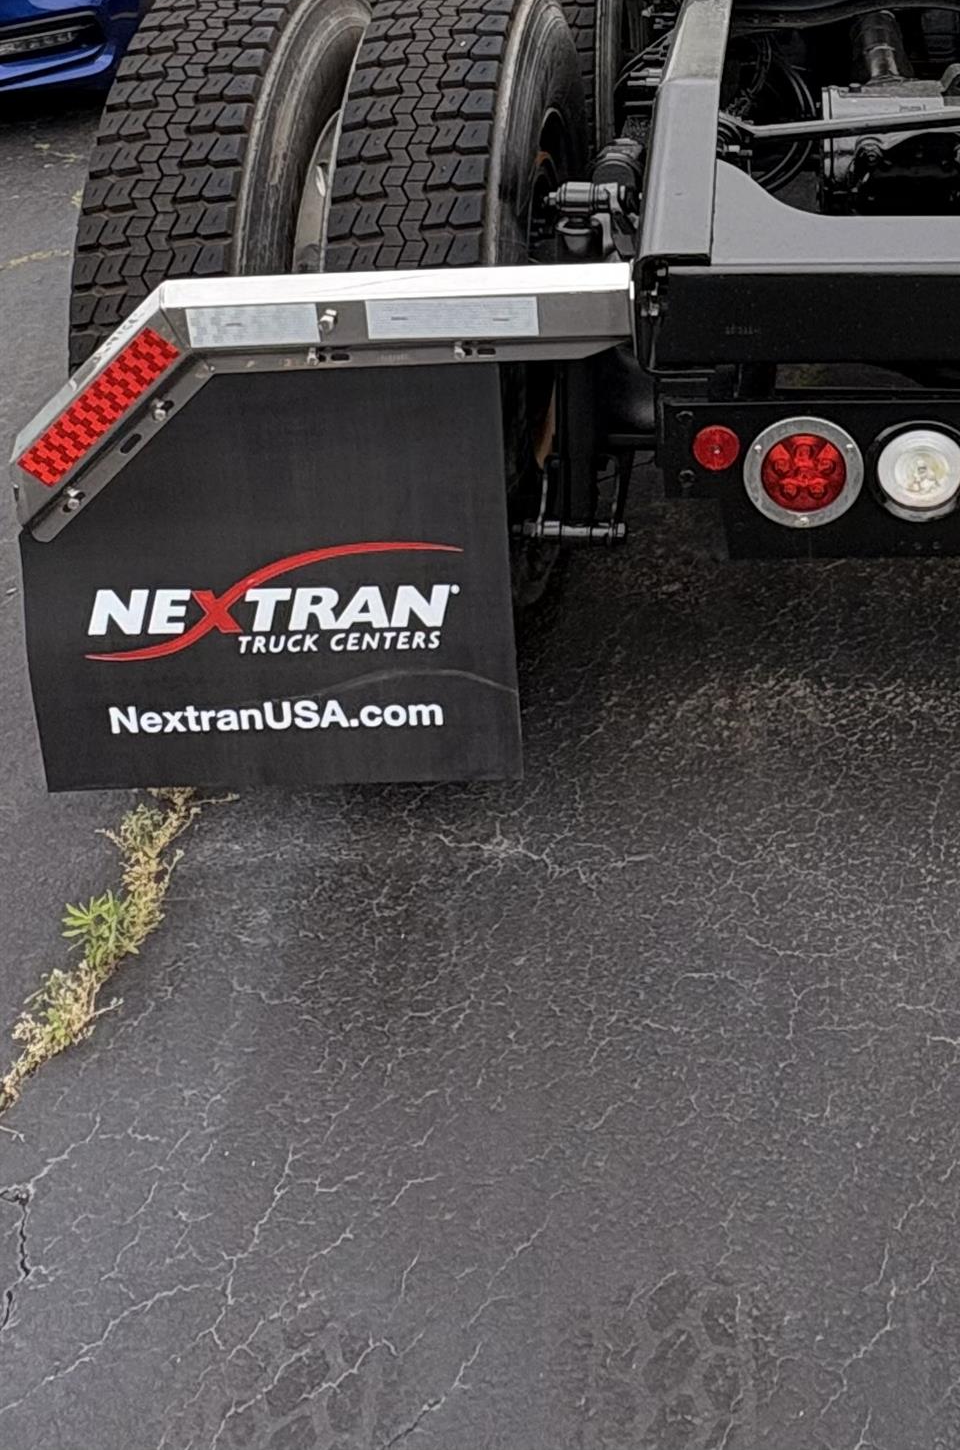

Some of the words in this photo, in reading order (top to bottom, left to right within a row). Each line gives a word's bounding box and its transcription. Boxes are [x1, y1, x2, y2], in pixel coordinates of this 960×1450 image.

[87, 584, 450, 636] NEXTRAN
[238, 634, 319, 654] TRUCK
[330, 631, 441, 652] CENTERS
[108, 699, 444, 735] NextranUSA.com
